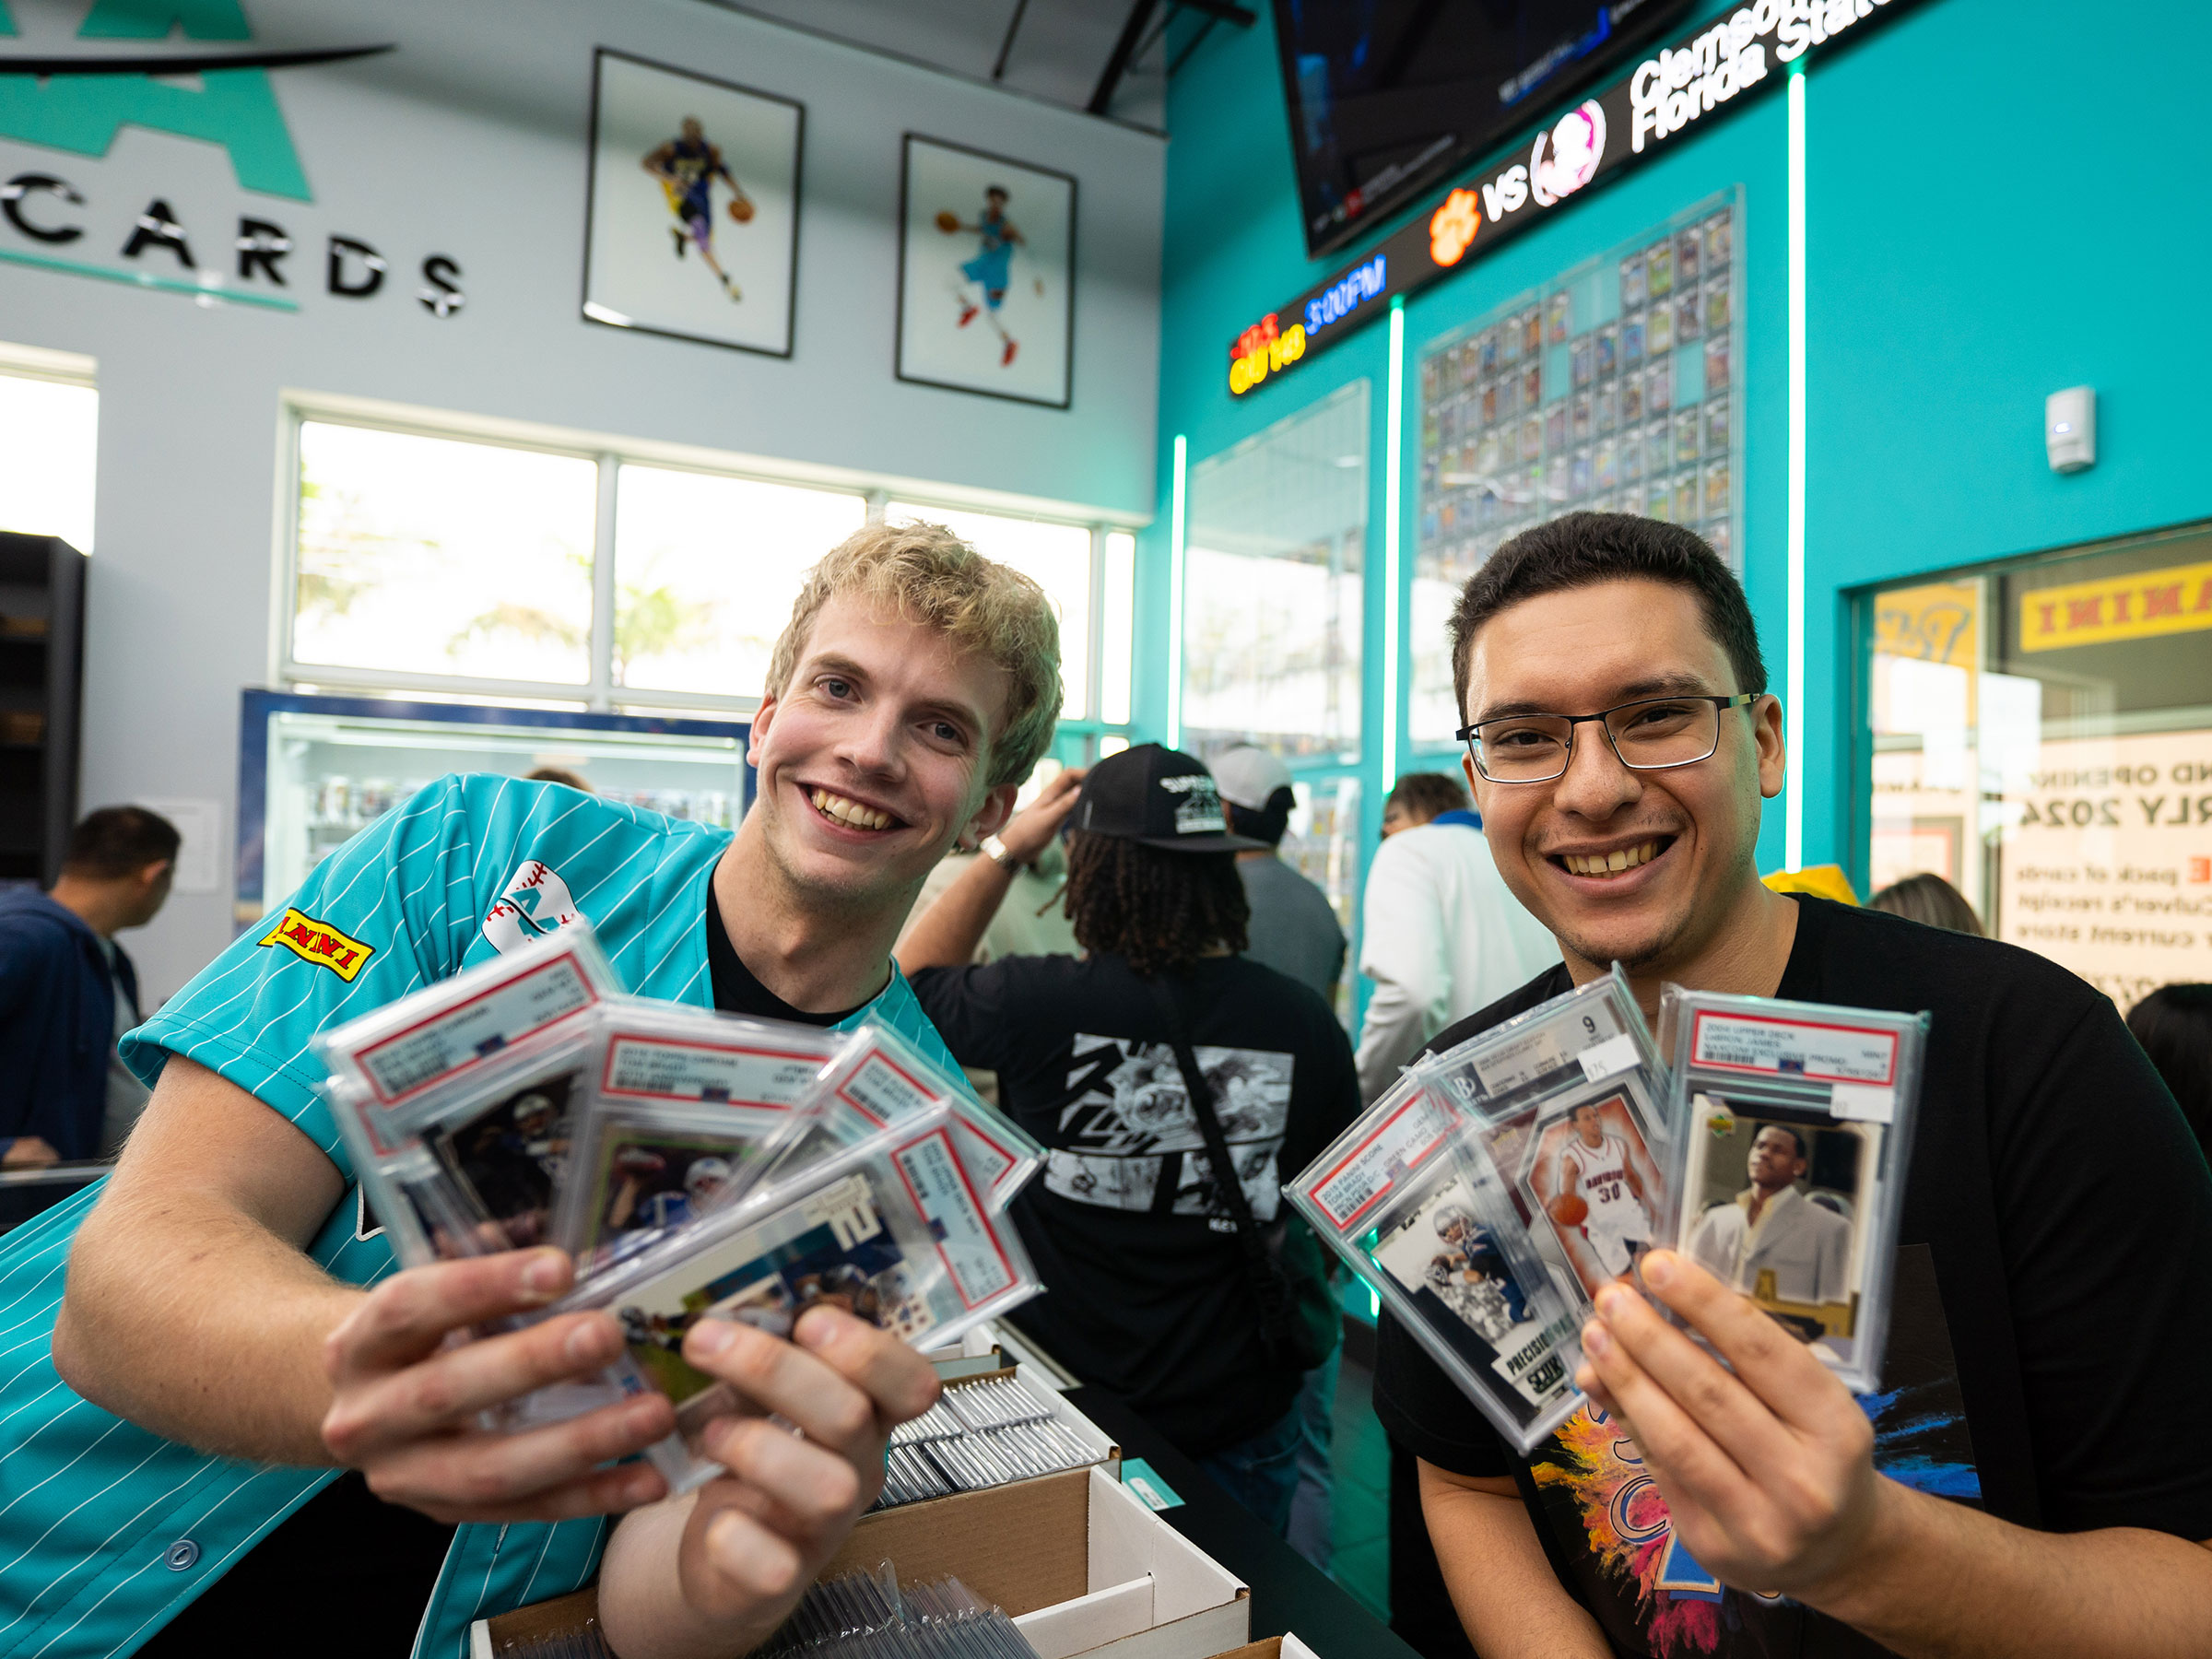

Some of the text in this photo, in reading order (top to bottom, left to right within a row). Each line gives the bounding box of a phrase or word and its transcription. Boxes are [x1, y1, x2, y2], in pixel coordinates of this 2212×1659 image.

[1, 171, 464, 317] CARDS
[1582, 1016, 1595, 1034] 9
[1733, 1026, 1765, 1036] UPPER
[1336, 1163, 1361, 1185] PANINI
[1359, 1144, 1382, 1164] SCORE
[1382, 1147, 1406, 1167] GREEN
[1326, 1171, 1366, 1206] TOM BRADY
[1597, 1182, 1621, 1205] 30
